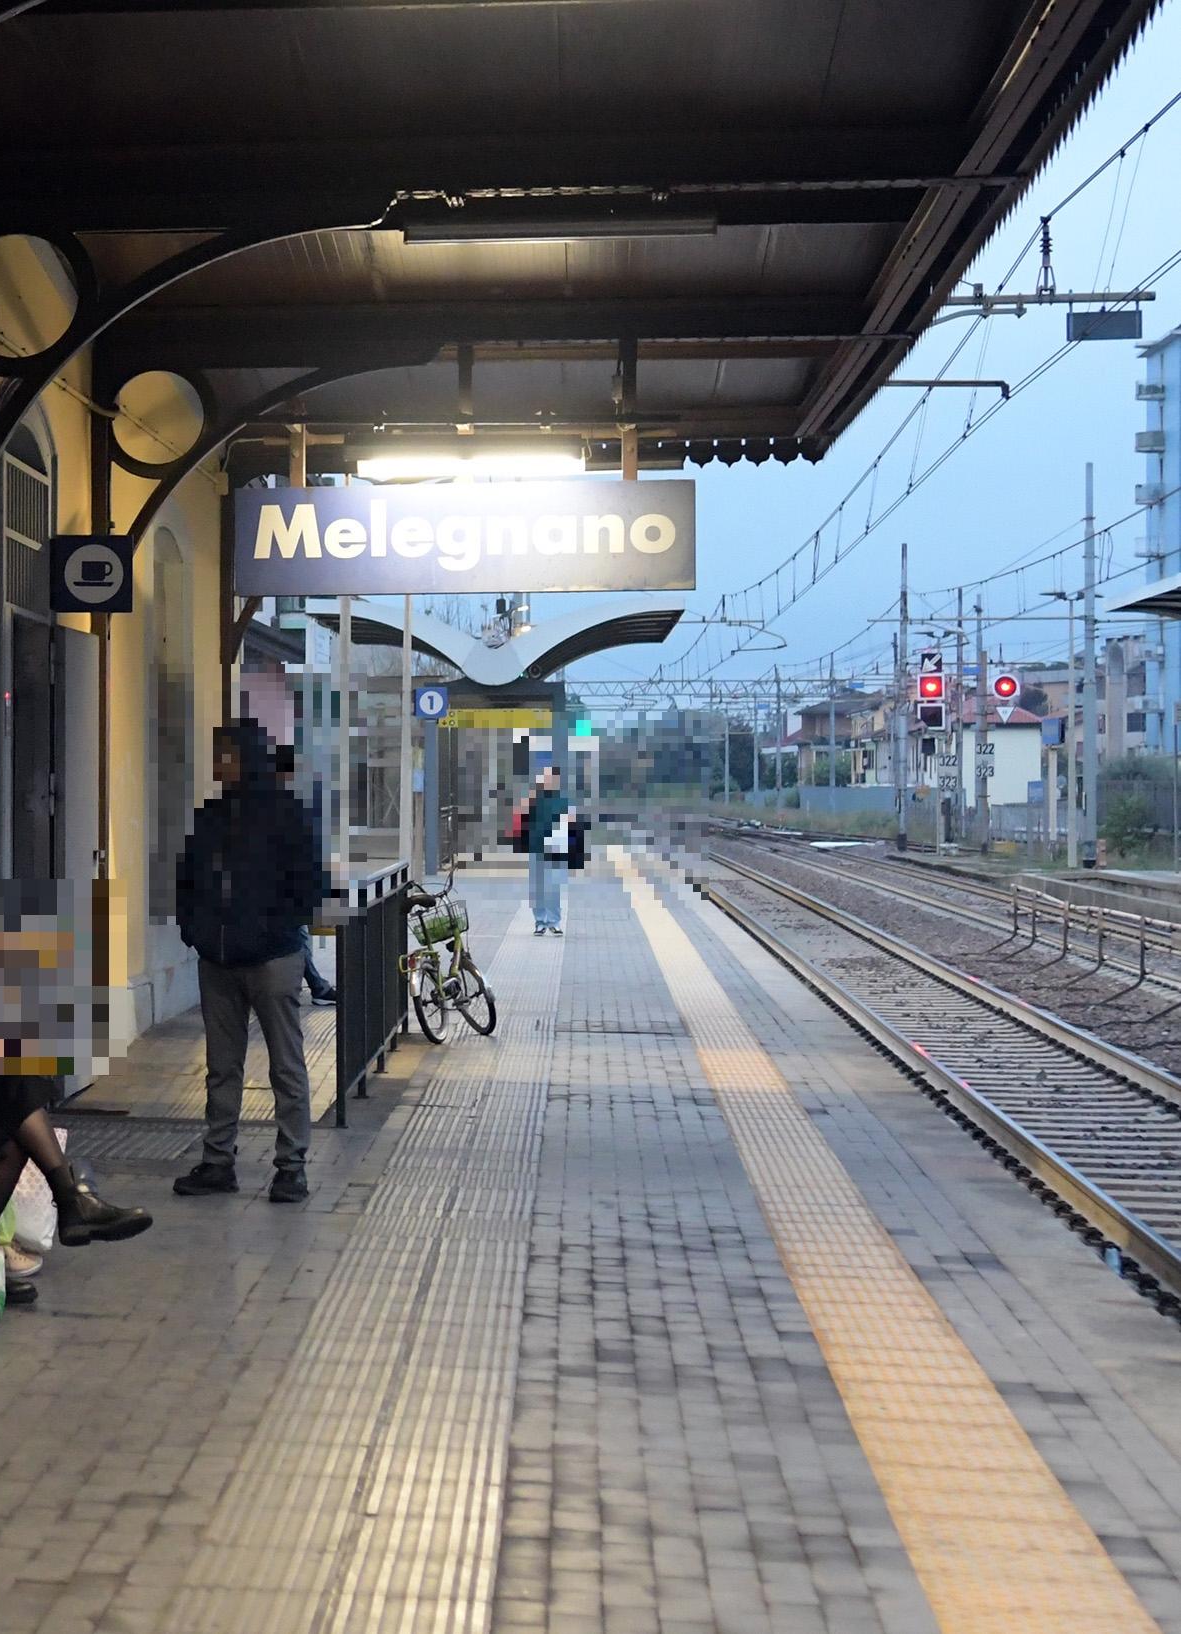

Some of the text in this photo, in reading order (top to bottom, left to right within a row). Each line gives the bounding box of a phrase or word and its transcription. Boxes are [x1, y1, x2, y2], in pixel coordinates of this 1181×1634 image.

[253, 498, 676, 572] Melegnano
[427, 695, 434, 710] 1
[976, 743, 995, 754] 322
[939, 755, 957, 766] 322
[976, 766, 994, 777] 323
